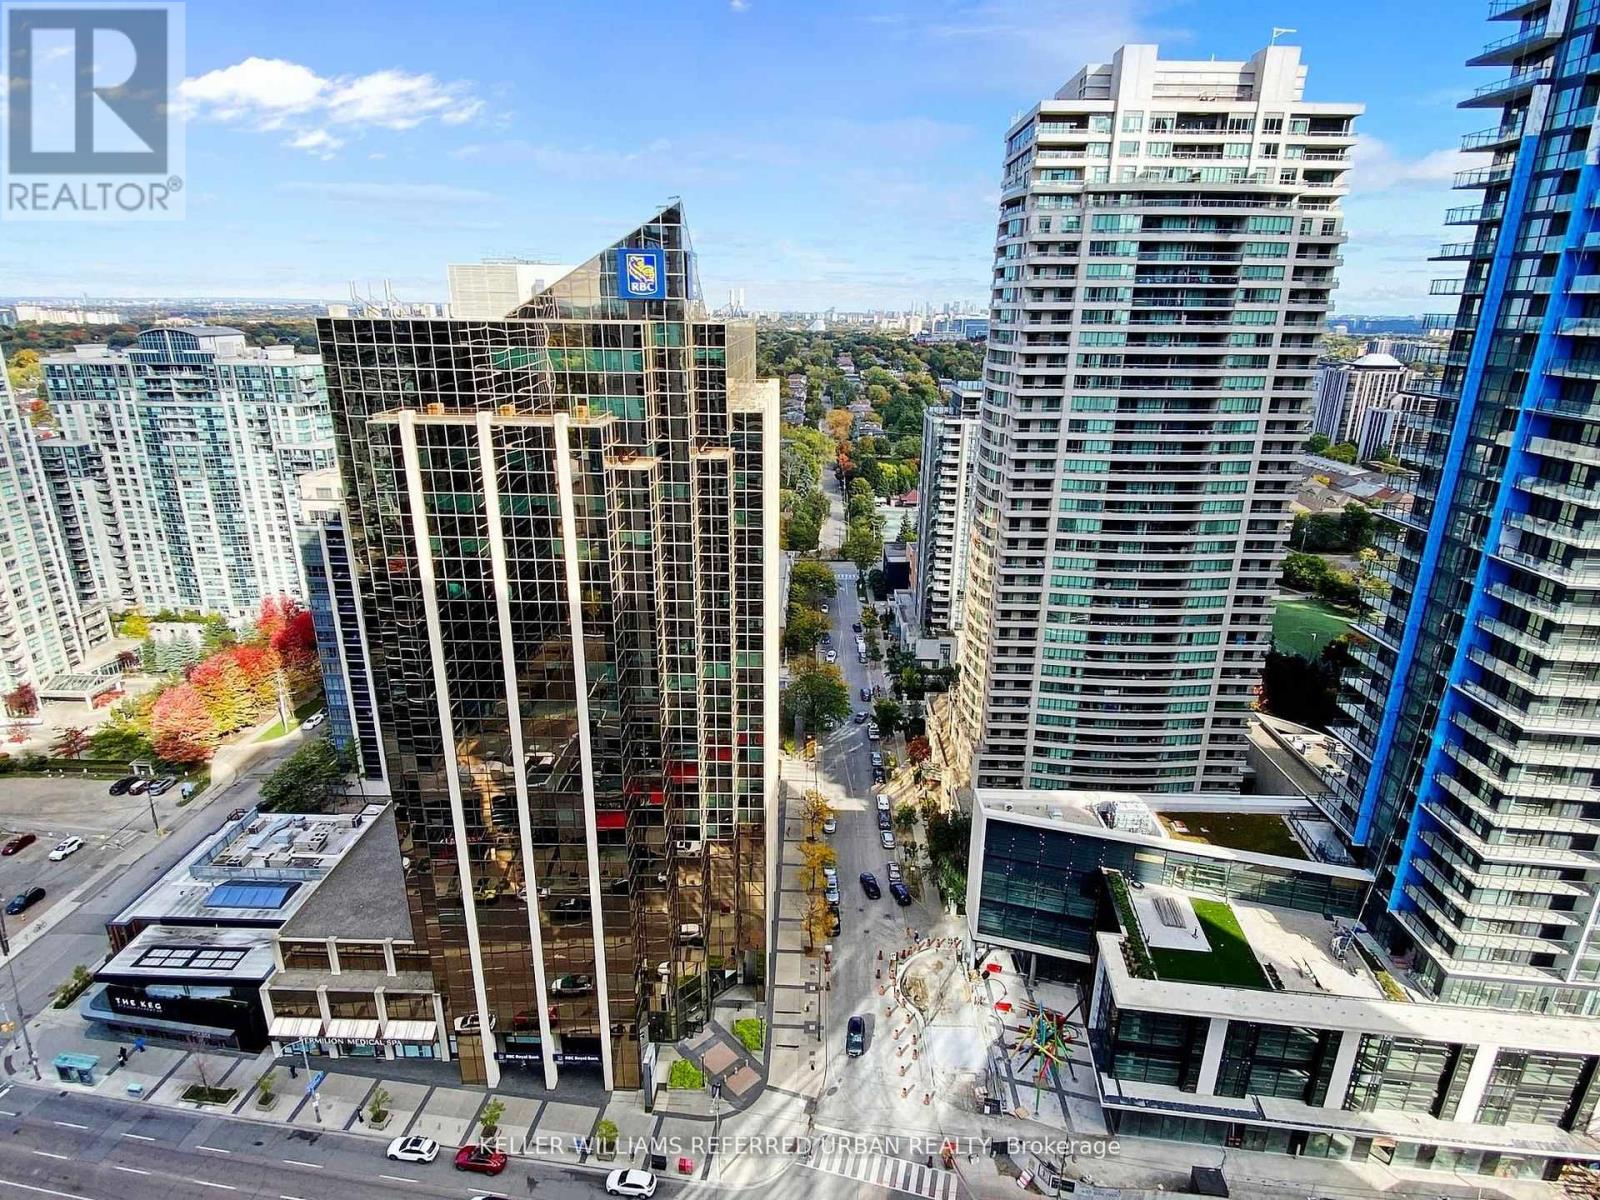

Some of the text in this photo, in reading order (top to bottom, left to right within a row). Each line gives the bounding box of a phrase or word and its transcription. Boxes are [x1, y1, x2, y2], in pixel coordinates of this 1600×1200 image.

[631, 282, 655, 292] RBC
[115, 997, 136, 1006] THE
[140, 1000, 161, 1010] KEG
[347, 1038, 384, 1047] MEDICAL
[386, 1039, 402, 1047] SPA
